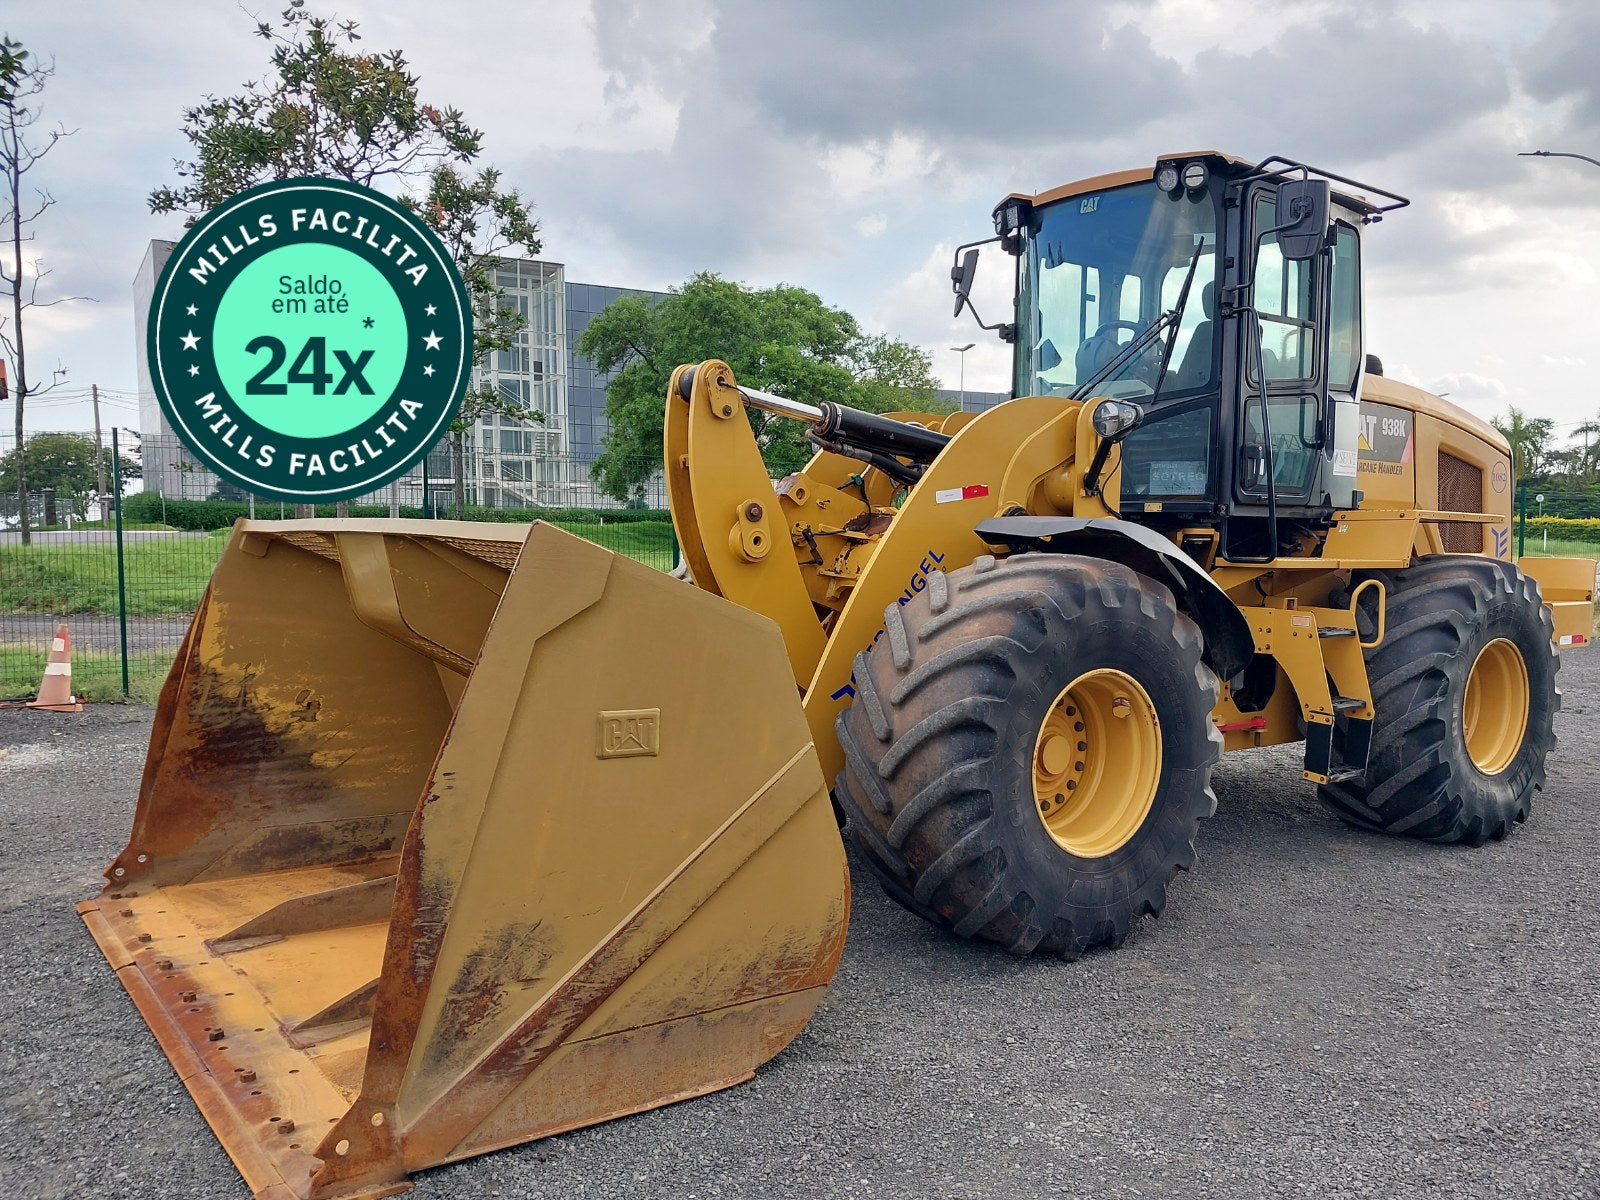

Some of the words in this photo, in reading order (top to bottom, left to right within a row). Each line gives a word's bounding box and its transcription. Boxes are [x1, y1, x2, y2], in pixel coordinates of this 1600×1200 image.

[1080, 197, 1100, 214] CAT
[1382, 418, 1406, 437] 938K
[603, 716, 655, 753] CAT
